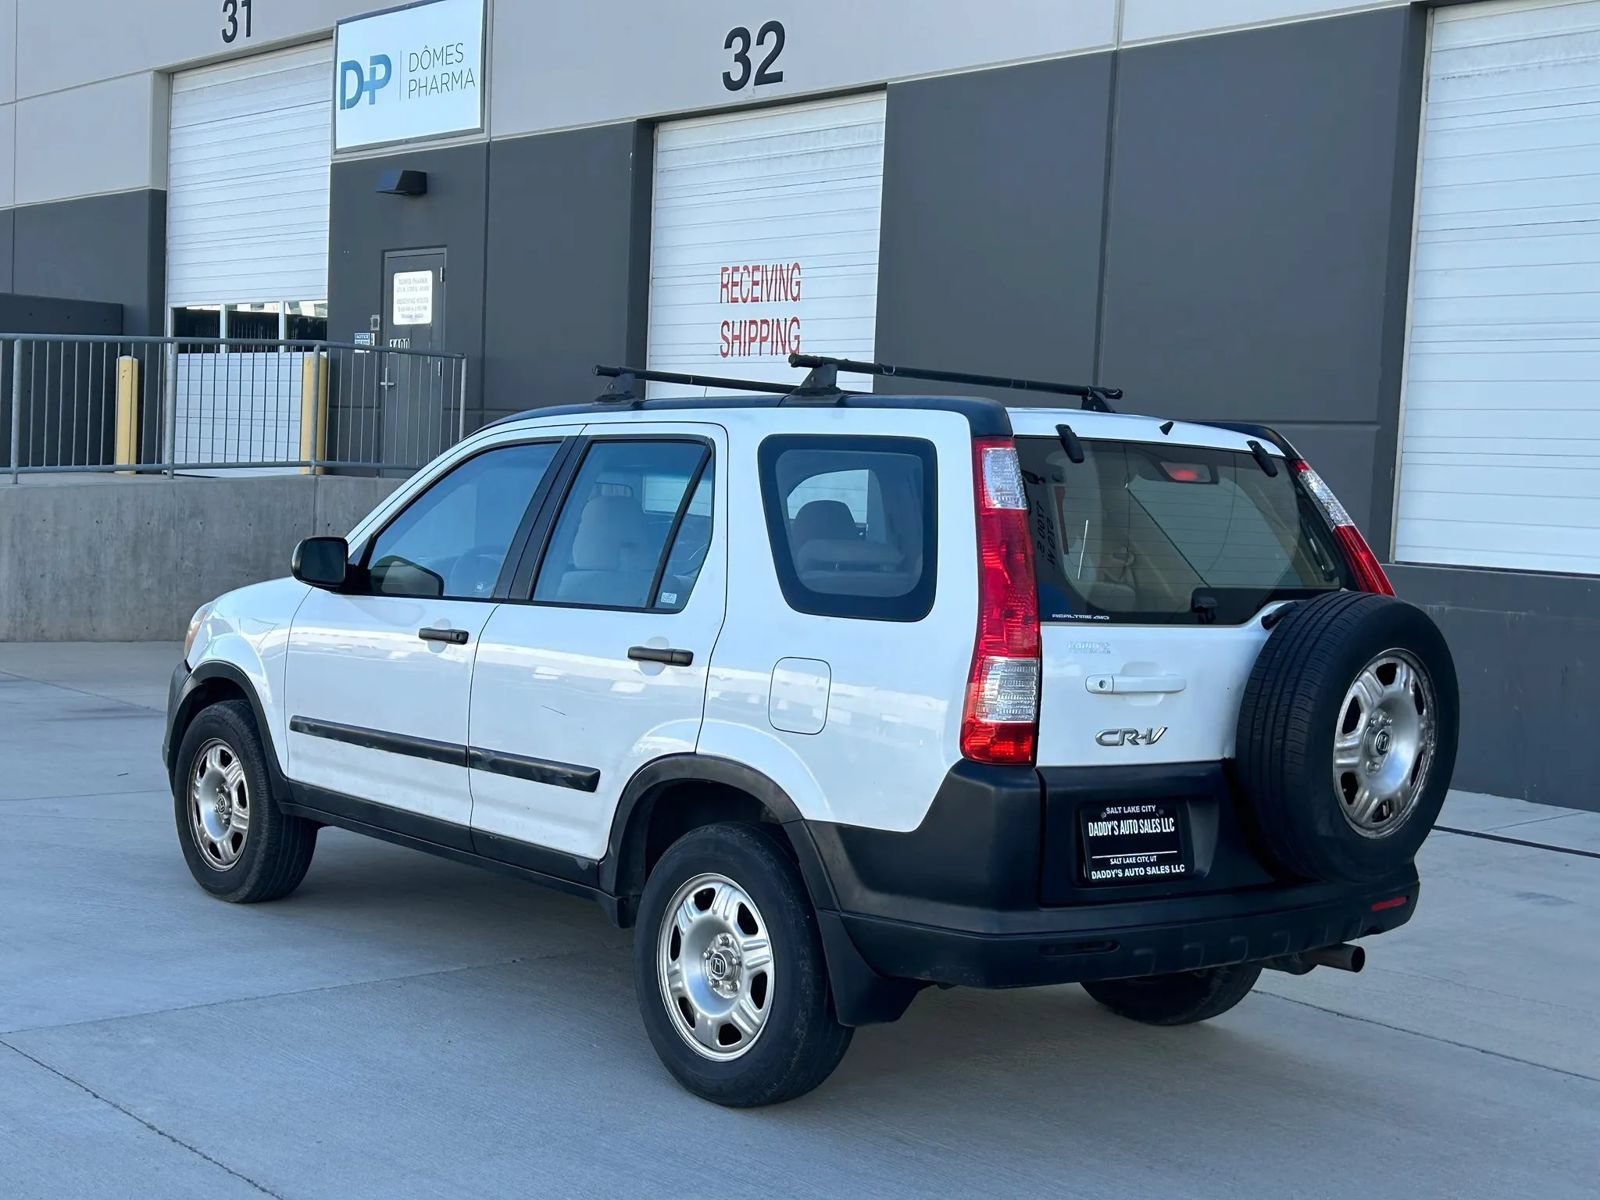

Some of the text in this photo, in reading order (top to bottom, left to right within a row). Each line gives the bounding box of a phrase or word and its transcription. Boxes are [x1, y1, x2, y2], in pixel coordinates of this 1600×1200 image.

[221, 0, 251, 43] 31
[408, 43, 464, 73] DÔMES
[722, 20, 785, 91] 32
[408, 68, 475, 99] PHARMA
[720, 262, 800, 304] RECEIVING
[720, 316, 800, 358] SHIPPING
[1095, 727, 1168, 746] CR-V
[1106, 805, 1156, 814] SALT LAKE CITY
[1088, 817, 1175, 837] DADDY'S AUTO SALES LLC
[1091, 864, 1185, 880] DADDY'S AUTO SALES LLC
